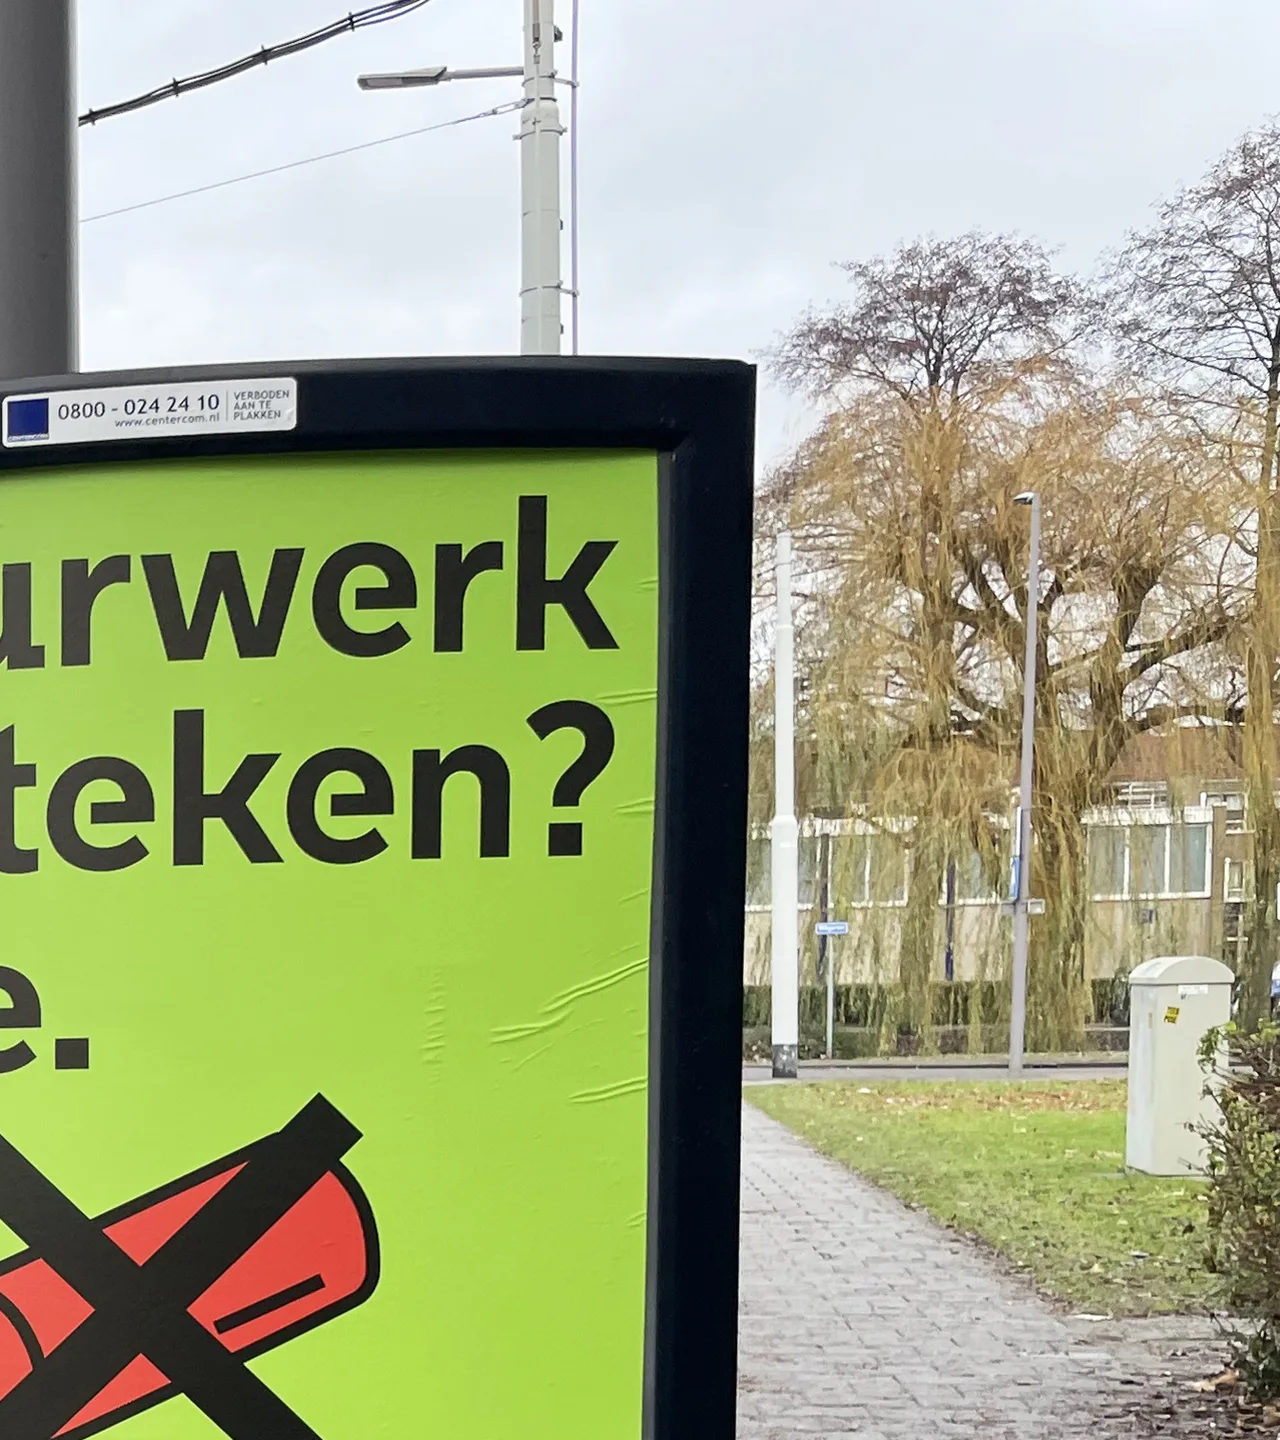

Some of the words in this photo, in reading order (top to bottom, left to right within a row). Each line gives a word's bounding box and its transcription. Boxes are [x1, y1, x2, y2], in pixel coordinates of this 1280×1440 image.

[233, 389, 290, 400] VERBODEN
[57, 401, 106, 421] 0800
[123, 397, 161, 416] 024
[166, 395, 190, 413] 24
[197, 394, 220, 411] 10
[233, 401, 255, 411] AAN
[259, 399, 272, 410] TE
[114, 412, 221, 428] www.centercom.nl
[233, 409, 281, 421] PLAKKEN
